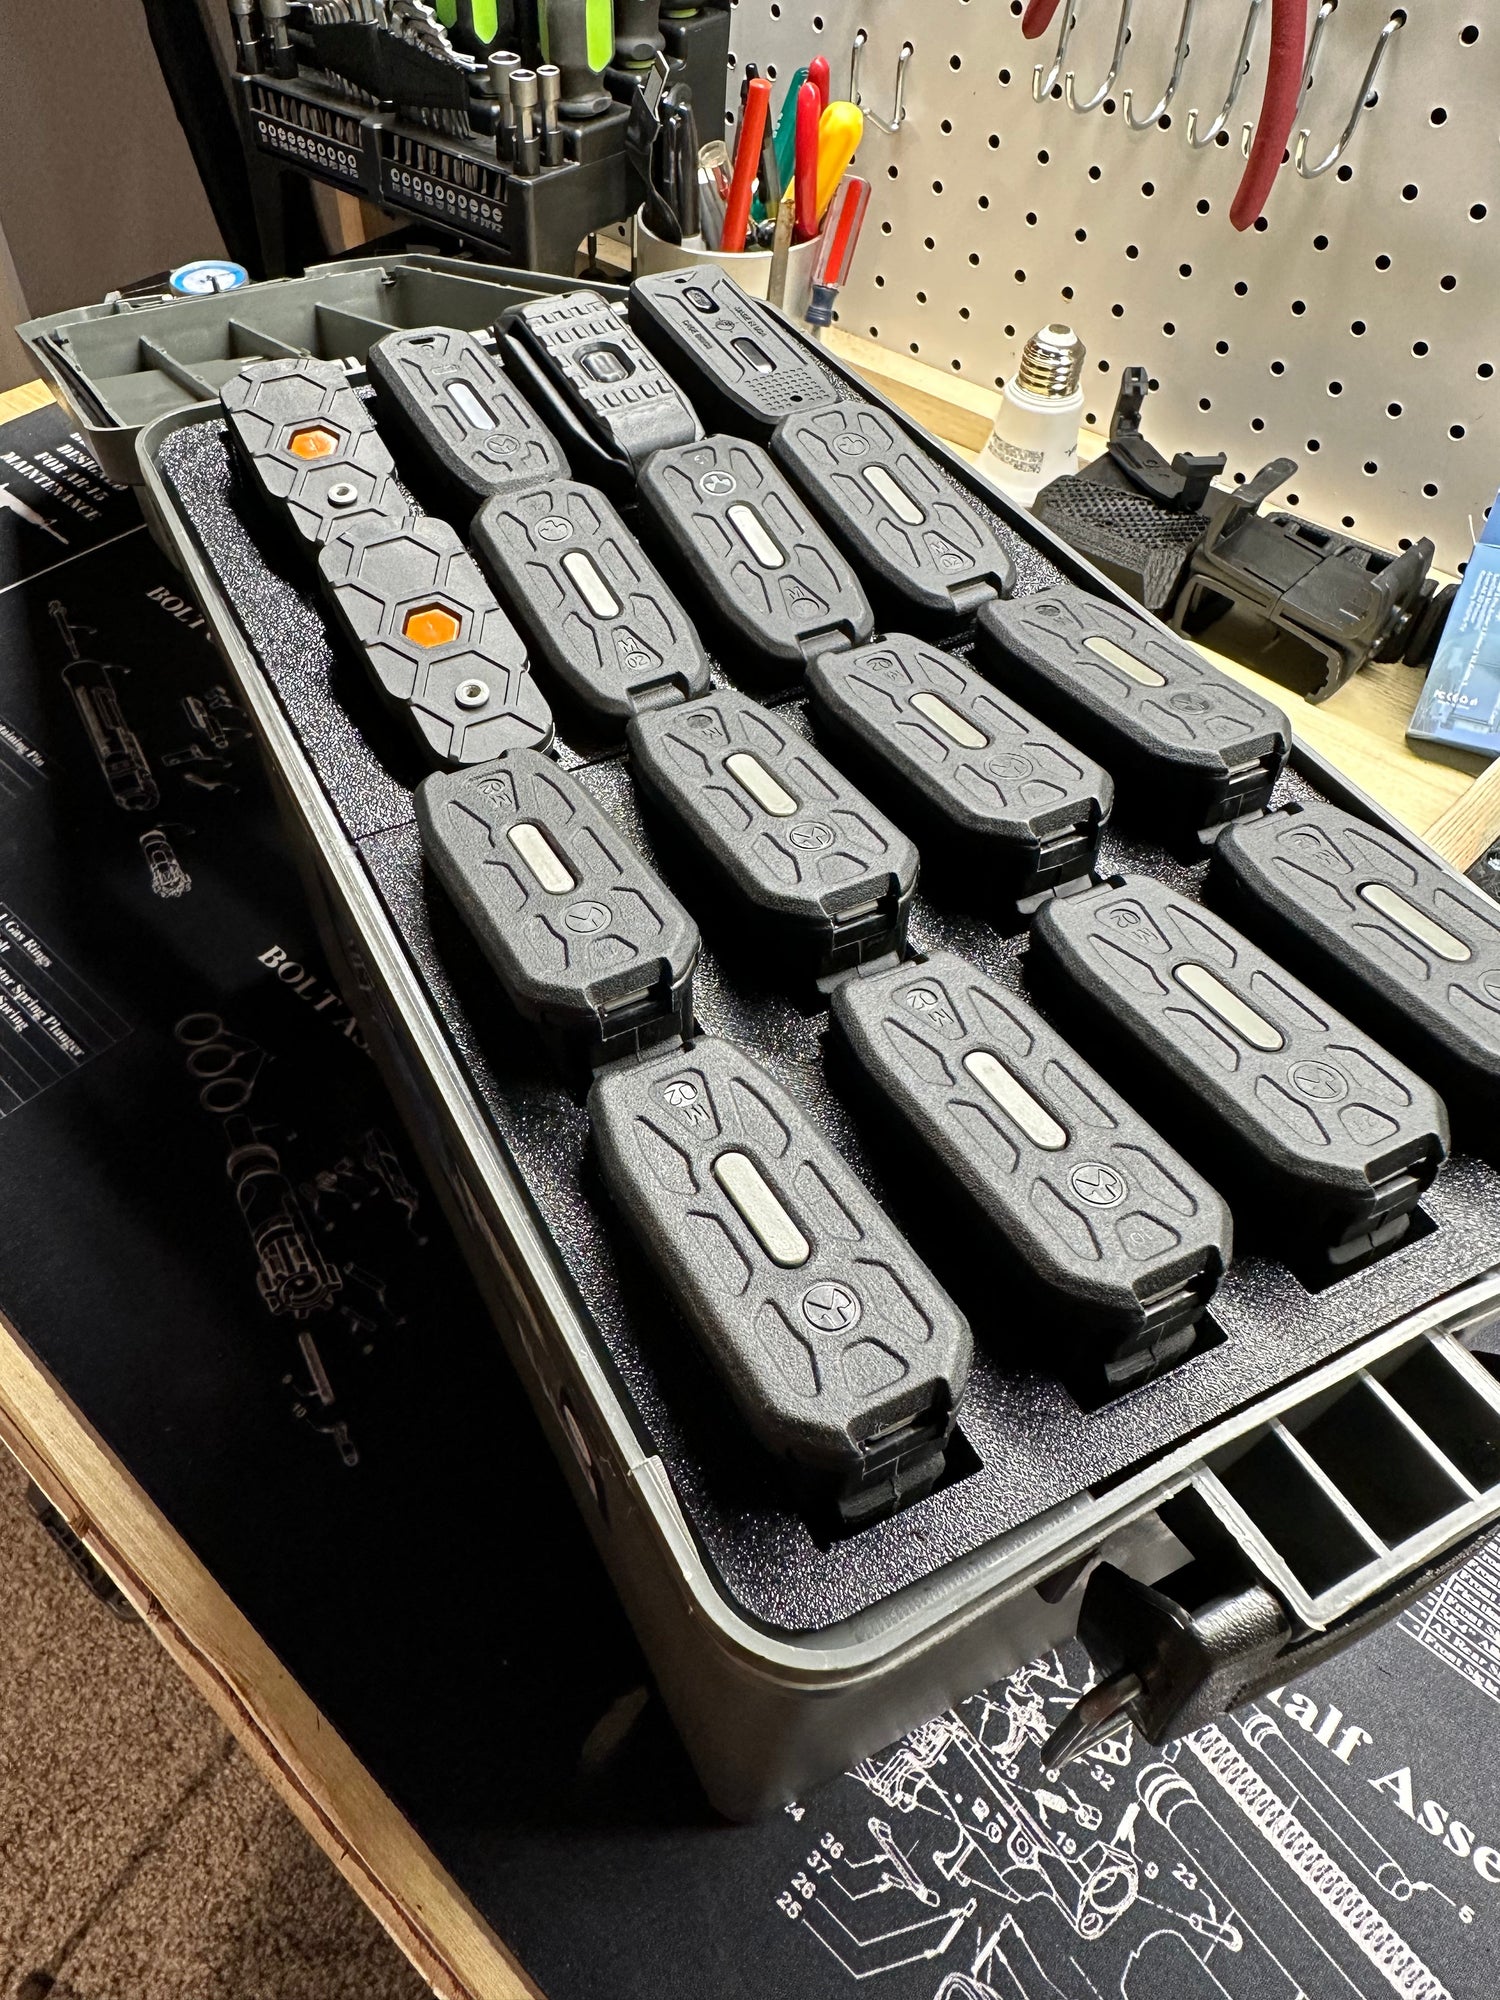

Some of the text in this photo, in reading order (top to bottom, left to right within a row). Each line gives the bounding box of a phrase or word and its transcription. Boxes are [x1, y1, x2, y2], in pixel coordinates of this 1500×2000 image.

[34, 451, 68, 474] FOR
[0, 451, 103, 521] MAINTENANCE
[145, 586, 205, 629] BOLT
[5, 920, 53, 968] Gas Rings
[257, 945, 343, 1011] BOLT
[11, 983, 47, 1021] Spring
[43, 1014, 86, 1057] Plunger
[1445, 1594, 1484, 1629] Front
[1424, 1632, 1463, 1668] Front
[1431, 1622, 1452, 1640] A2
[1453, 1636, 1488, 1667] Rear
[1090, 1763, 1116, 1792] 32
[820, 1831, 845, 1860] 36
[1055, 1830, 1078, 1856] 19
[806, 1849, 832, 1875] 37
[1143, 1861, 1160, 1880] 9
[1171, 1862, 1199, 1891] 23
[790, 1871, 817, 1900] 26
